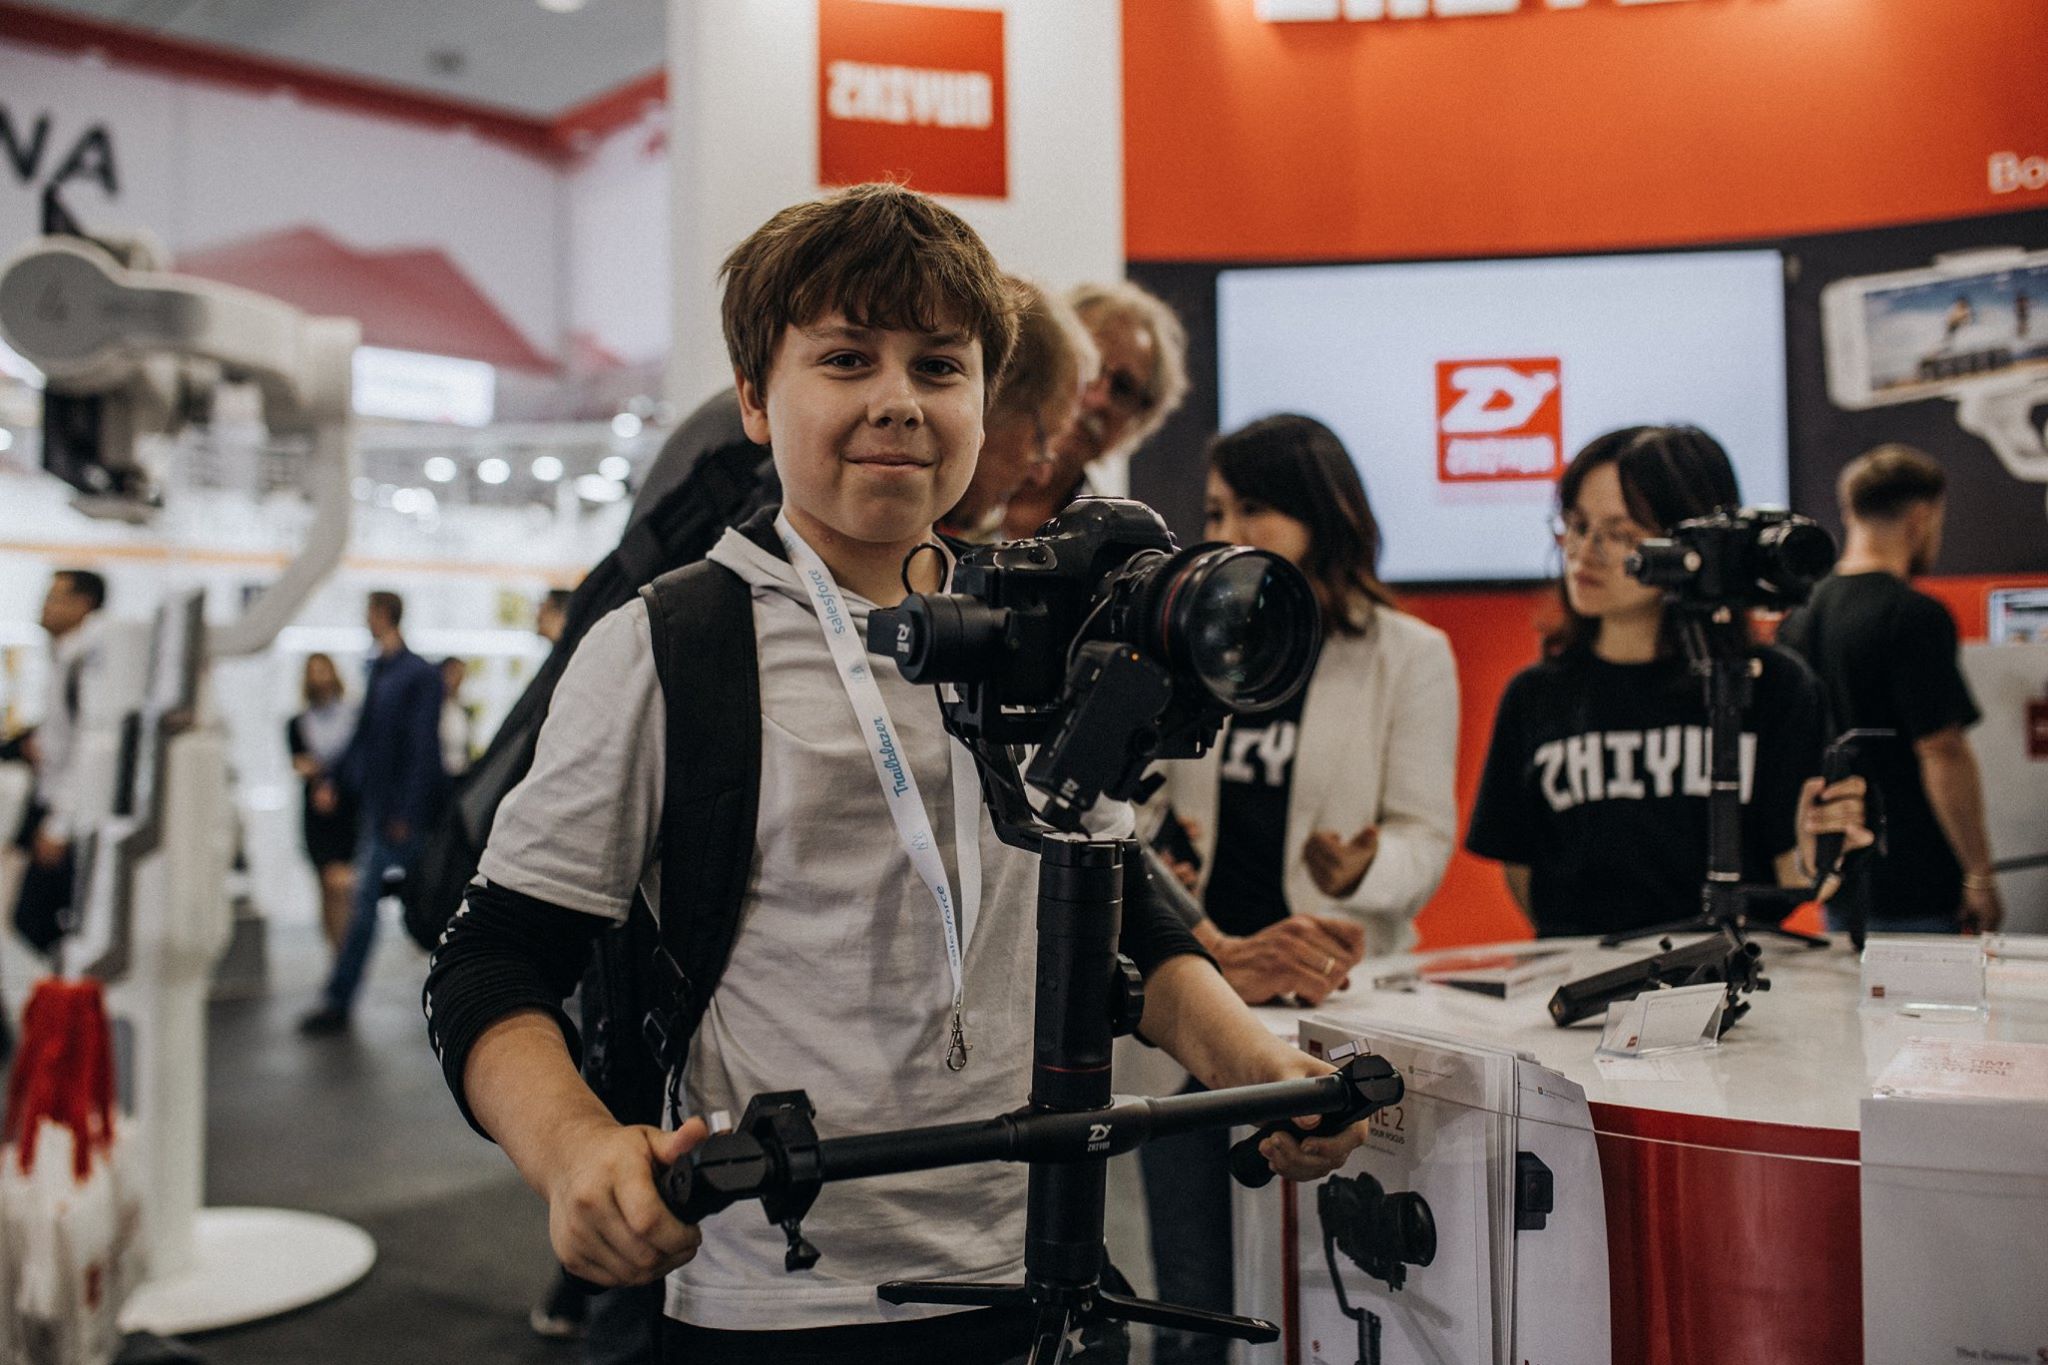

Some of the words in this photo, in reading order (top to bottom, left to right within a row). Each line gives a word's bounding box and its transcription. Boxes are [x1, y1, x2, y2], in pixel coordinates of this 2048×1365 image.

[808, 568, 846, 635] salesforce
[873, 716, 909, 798] Trailblazer
[1395, 1105, 1405, 1132] 2
